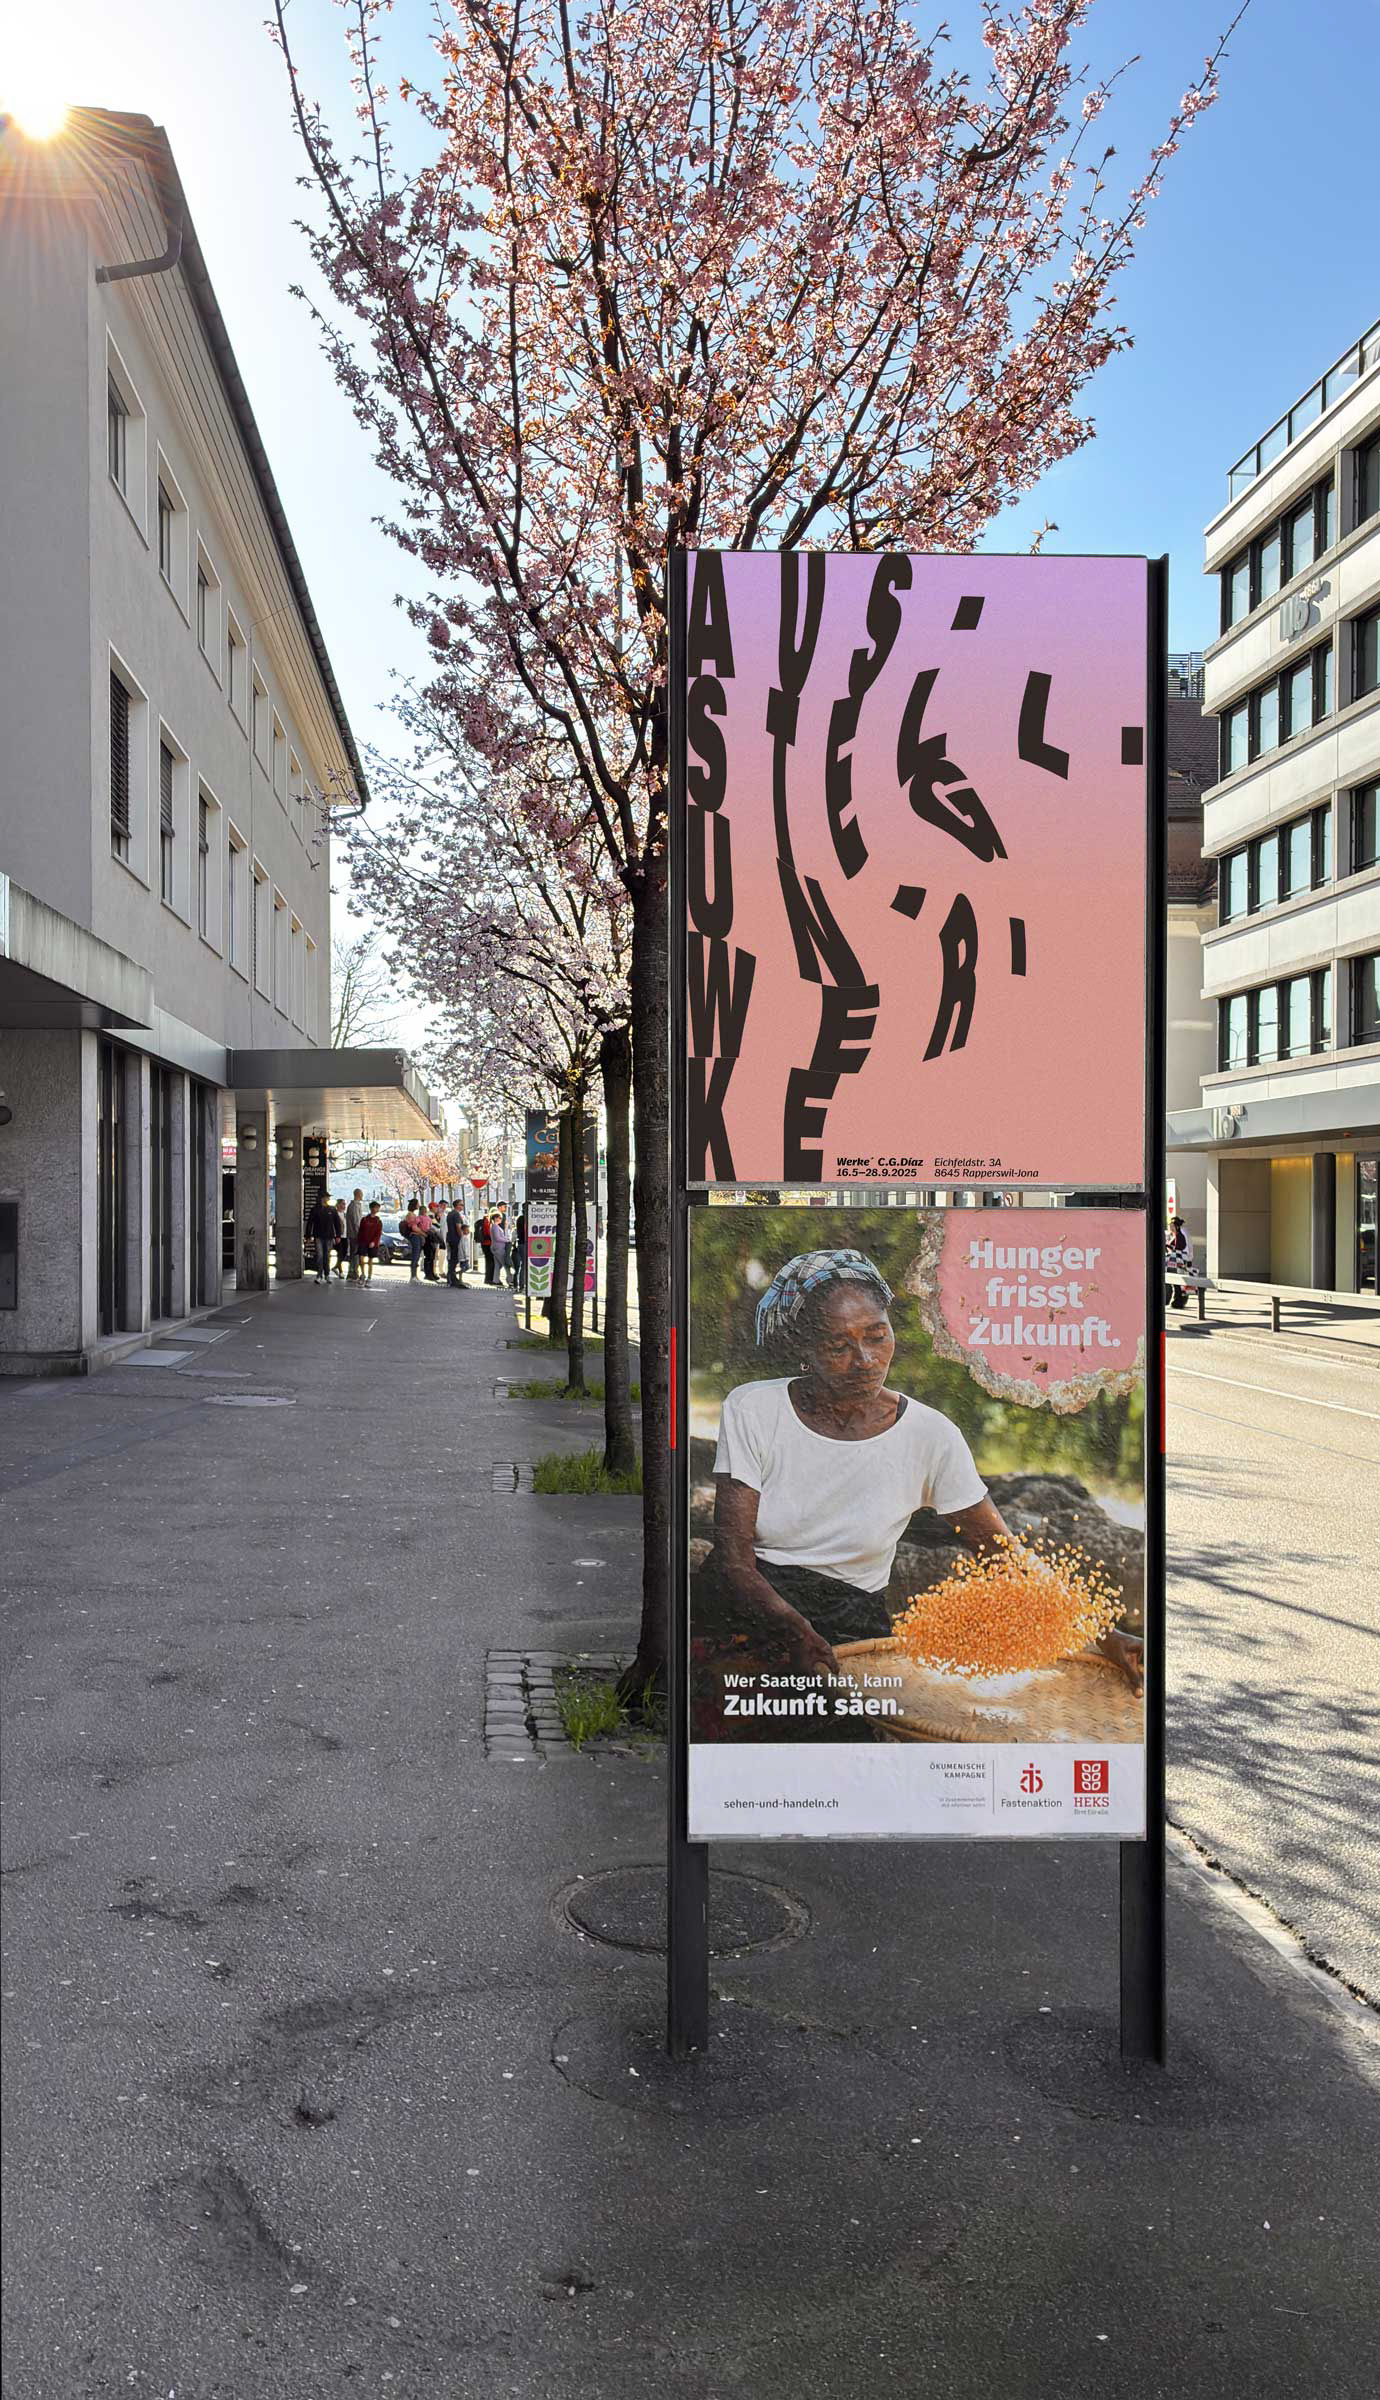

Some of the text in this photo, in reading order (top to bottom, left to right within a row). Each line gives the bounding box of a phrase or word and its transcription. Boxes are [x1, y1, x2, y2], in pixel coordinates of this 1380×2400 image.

[934, 1157, 1002, 1169] Eichfeldstr. 3A
[934, 1168, 1039, 1179] 8645 Rapperswil-Jona
[969, 1240, 1102, 1278] Hunger
[985, 1274, 1084, 1309] frisst
[967, 1315, 1121, 1347] Zukunft.
[723, 1673, 903, 1691] Wer Saatgut hat, kann
[723, 1691, 905, 1716] Zukunft säen.
[929, 1761, 986, 1770] ÖKUMENISCHE
[723, 1799, 839, 1809] sehen-und-handeln.ch
[1001, 1798, 1063, 1808] Fastenaktion
[1073, 1796, 1110, 1808] HEKS
